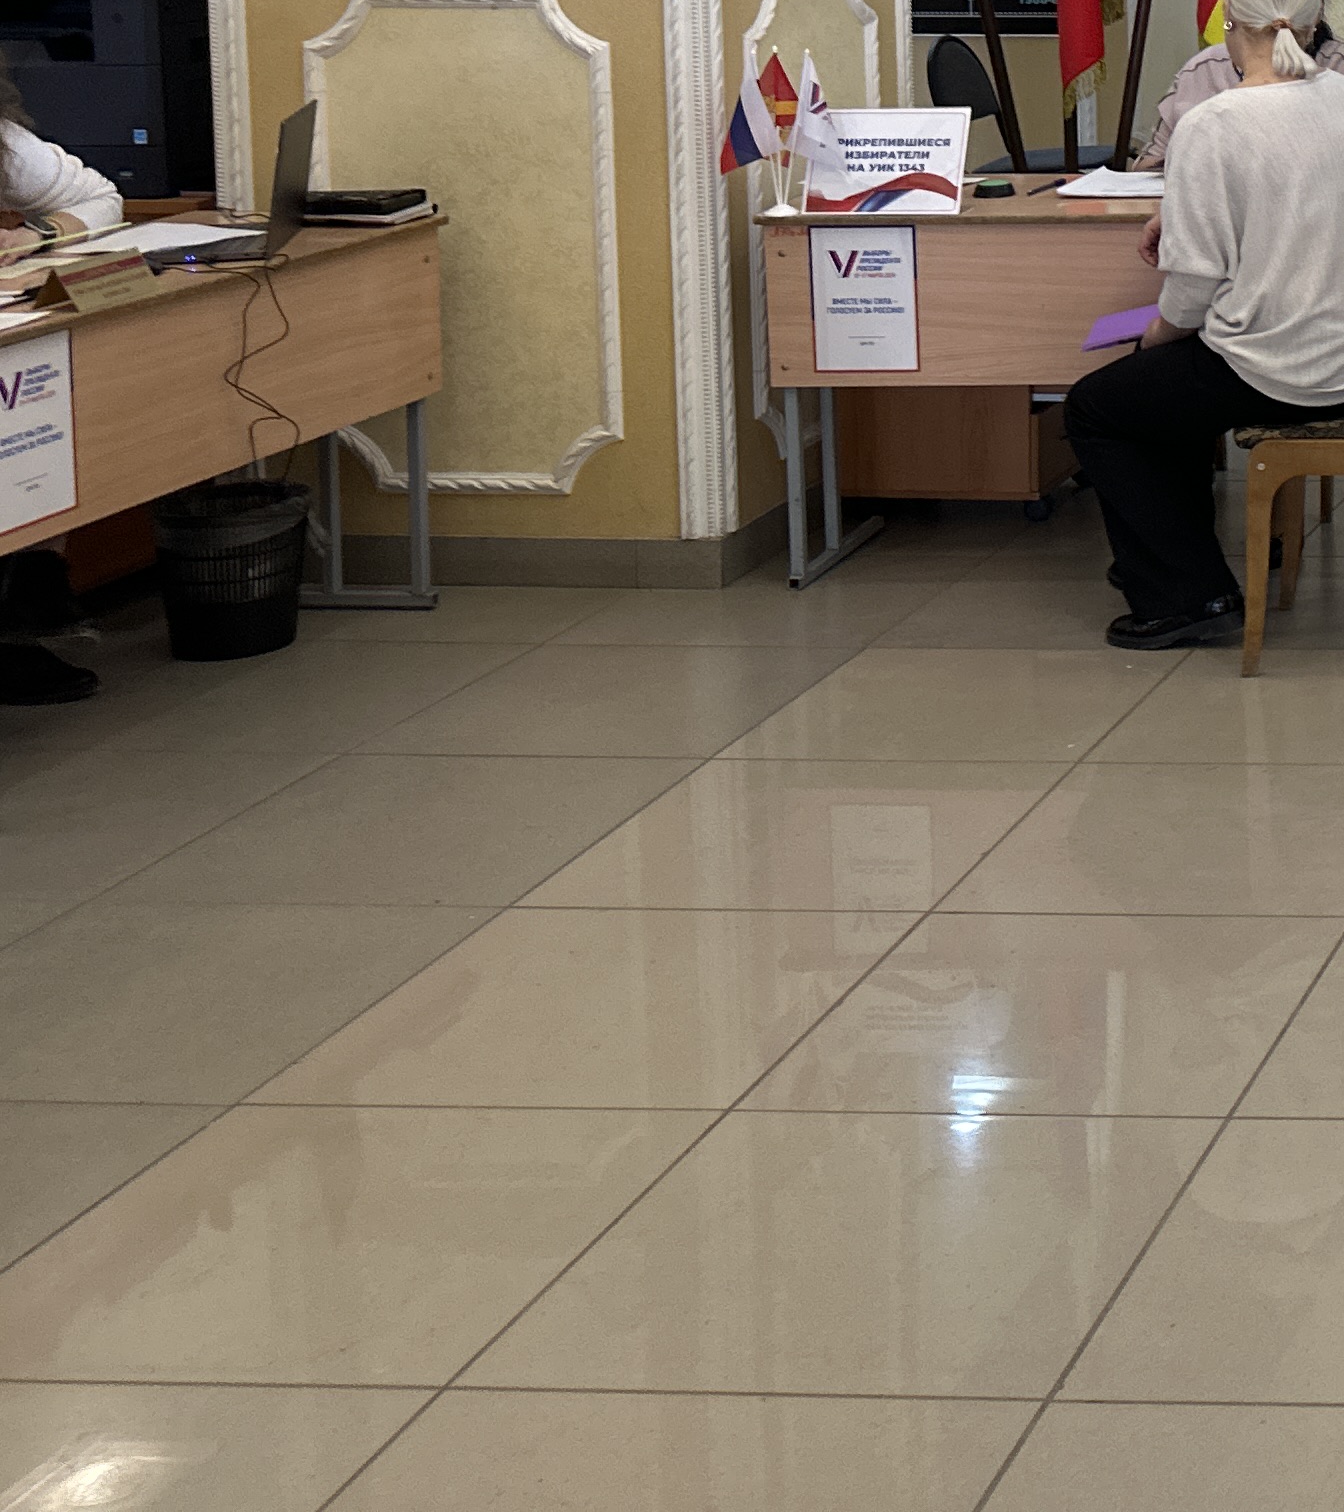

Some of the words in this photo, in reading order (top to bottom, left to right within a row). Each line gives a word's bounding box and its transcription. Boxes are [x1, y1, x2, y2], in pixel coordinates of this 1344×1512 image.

[838, 138, 951, 147] РИКРЕПИВШИЕСЯ
[845, 151, 930, 160] ИЗБИРАТЕЛИ
[847, 164, 865, 172] НА
[869, 164, 894, 172] УИК
[898, 164, 925, 172] 1343
